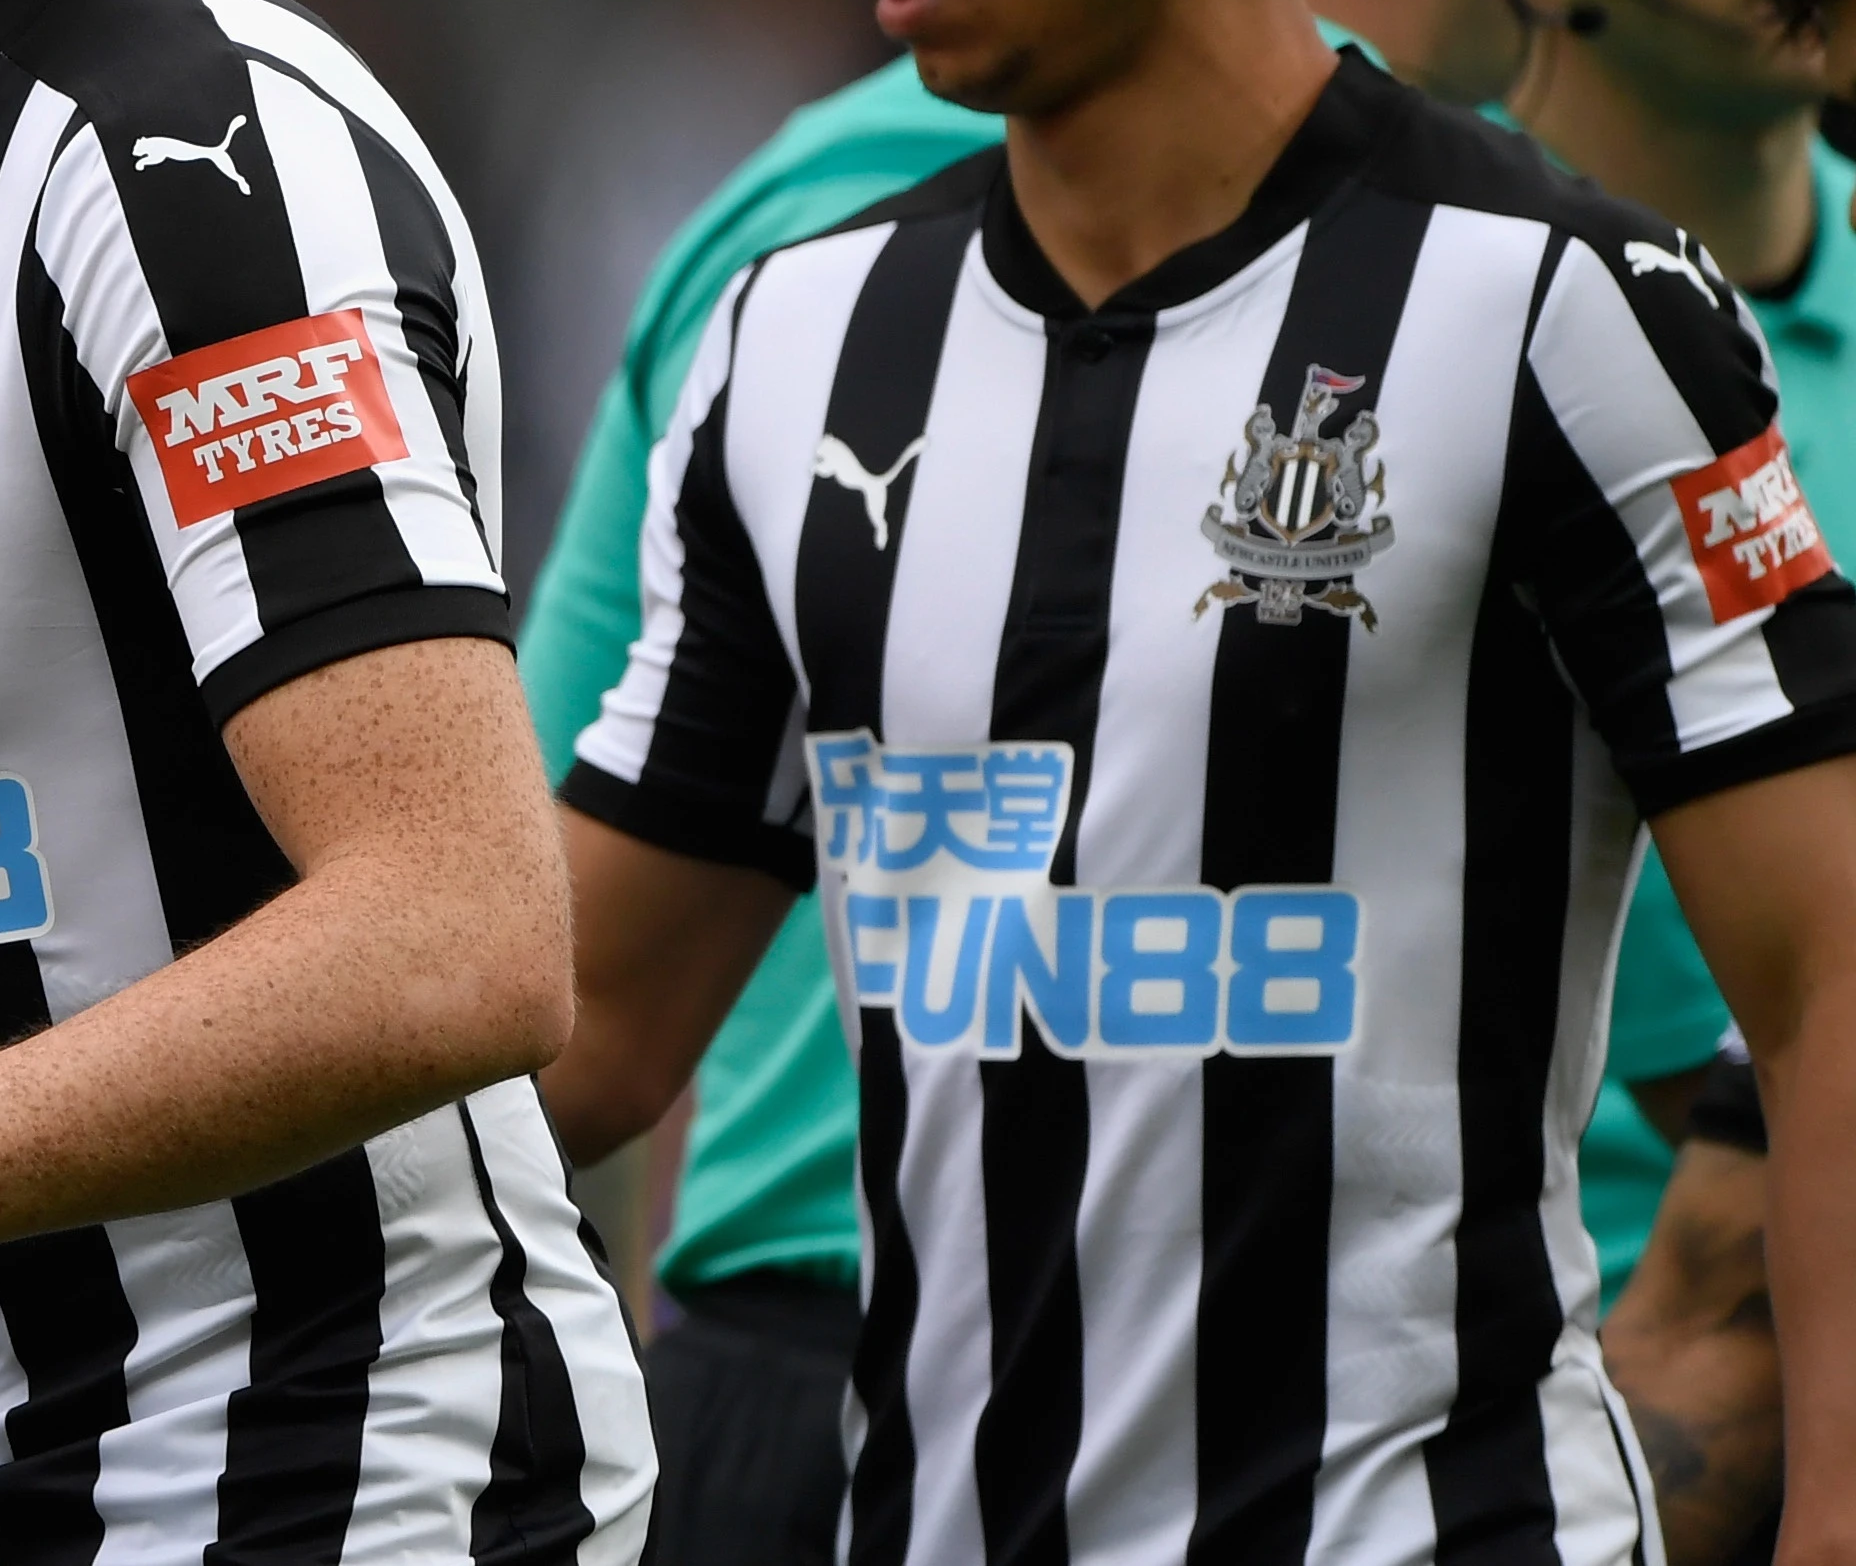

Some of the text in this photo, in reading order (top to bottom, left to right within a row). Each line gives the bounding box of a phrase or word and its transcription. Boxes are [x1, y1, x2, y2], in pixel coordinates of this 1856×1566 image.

[155, 339, 363, 448] MRF
[193, 400, 363, 484] TYRES
[1304, 550, 1364, 568] UNITED
[846, 891, 1359, 1051] FUN88
